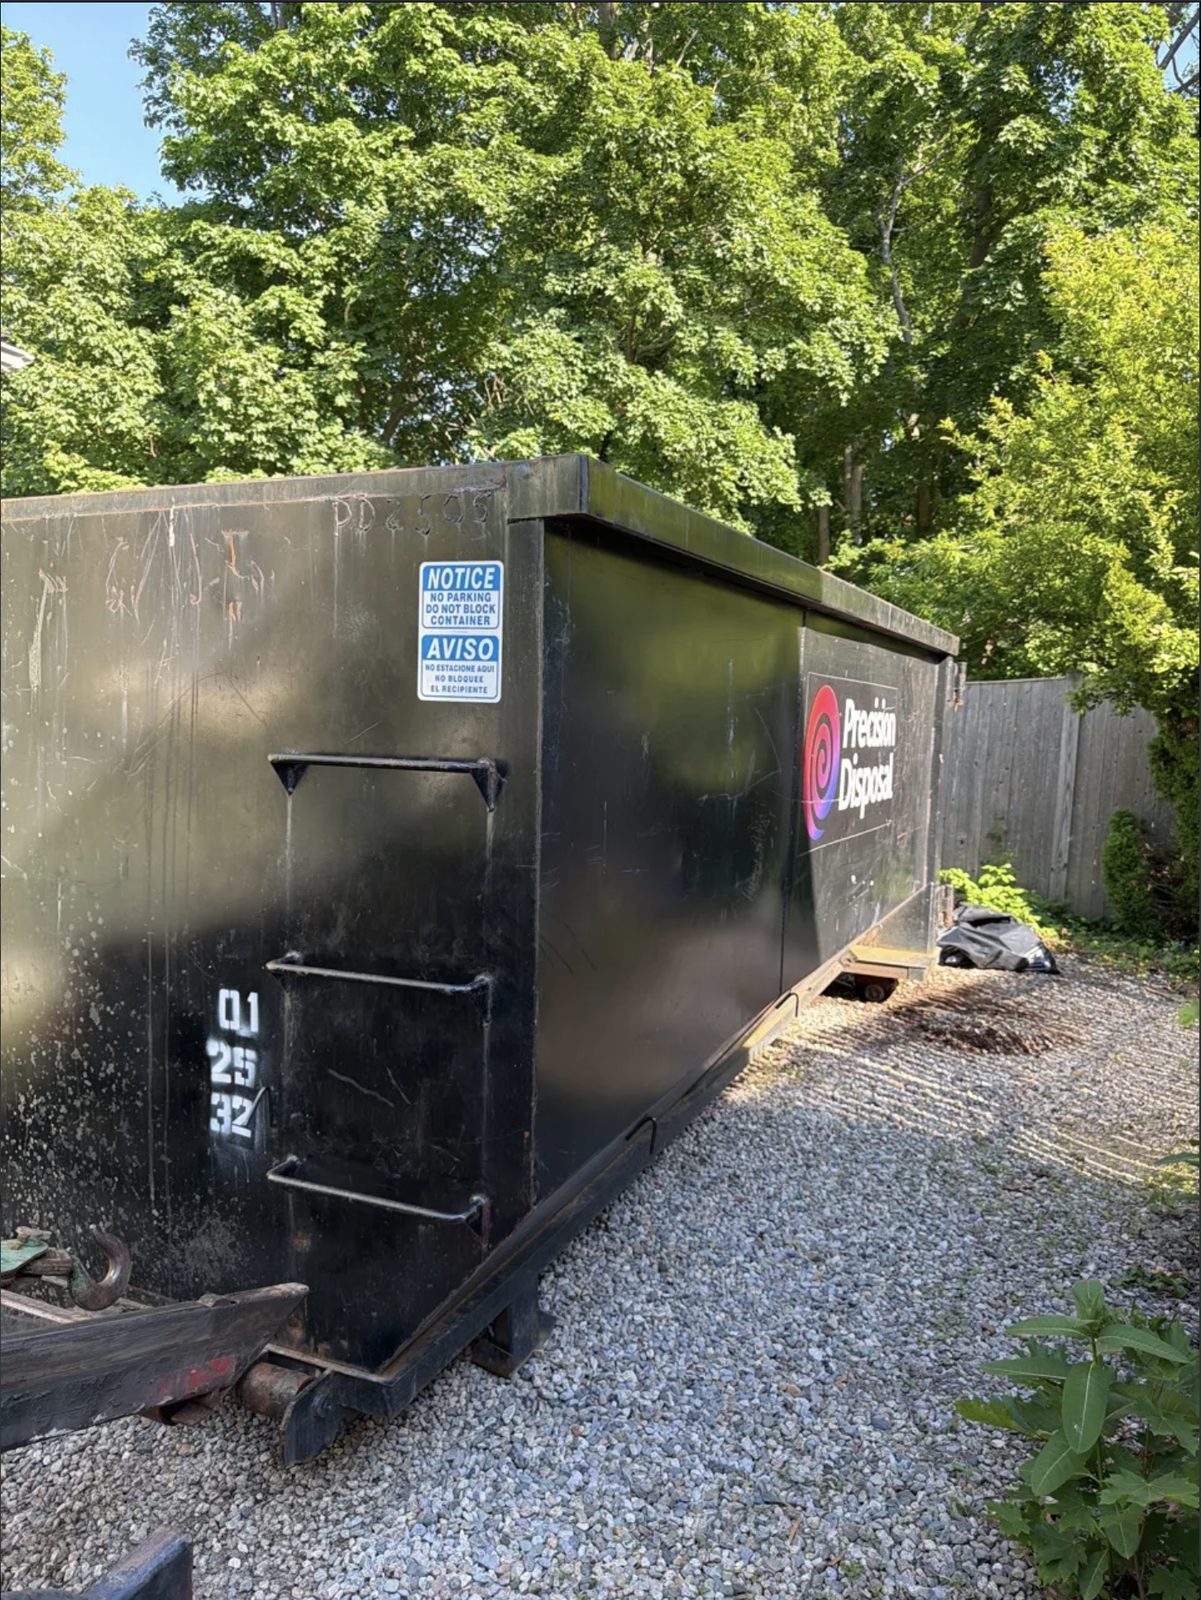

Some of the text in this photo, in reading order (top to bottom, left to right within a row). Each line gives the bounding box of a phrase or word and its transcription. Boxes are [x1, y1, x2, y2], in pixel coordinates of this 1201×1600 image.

[427, 567, 496, 590] NOTICE
[430, 592, 491, 602] NO PARKING
[426, 604, 496, 614] DO NOT BLOCK
[430, 615, 490, 626] CONTAINER
[426, 638, 494, 660] AVISO
[436, 664, 475, 672] ESTACIONE
[477, 665, 494, 673] AQUI
[448, 675, 484, 683] BLOQUEE
[442, 685, 488, 694] RECIPIENTE
[842, 697, 897, 749] Precision
[838, 752, 894, 820] Disposal
[206, 1037, 258, 1088] 25
